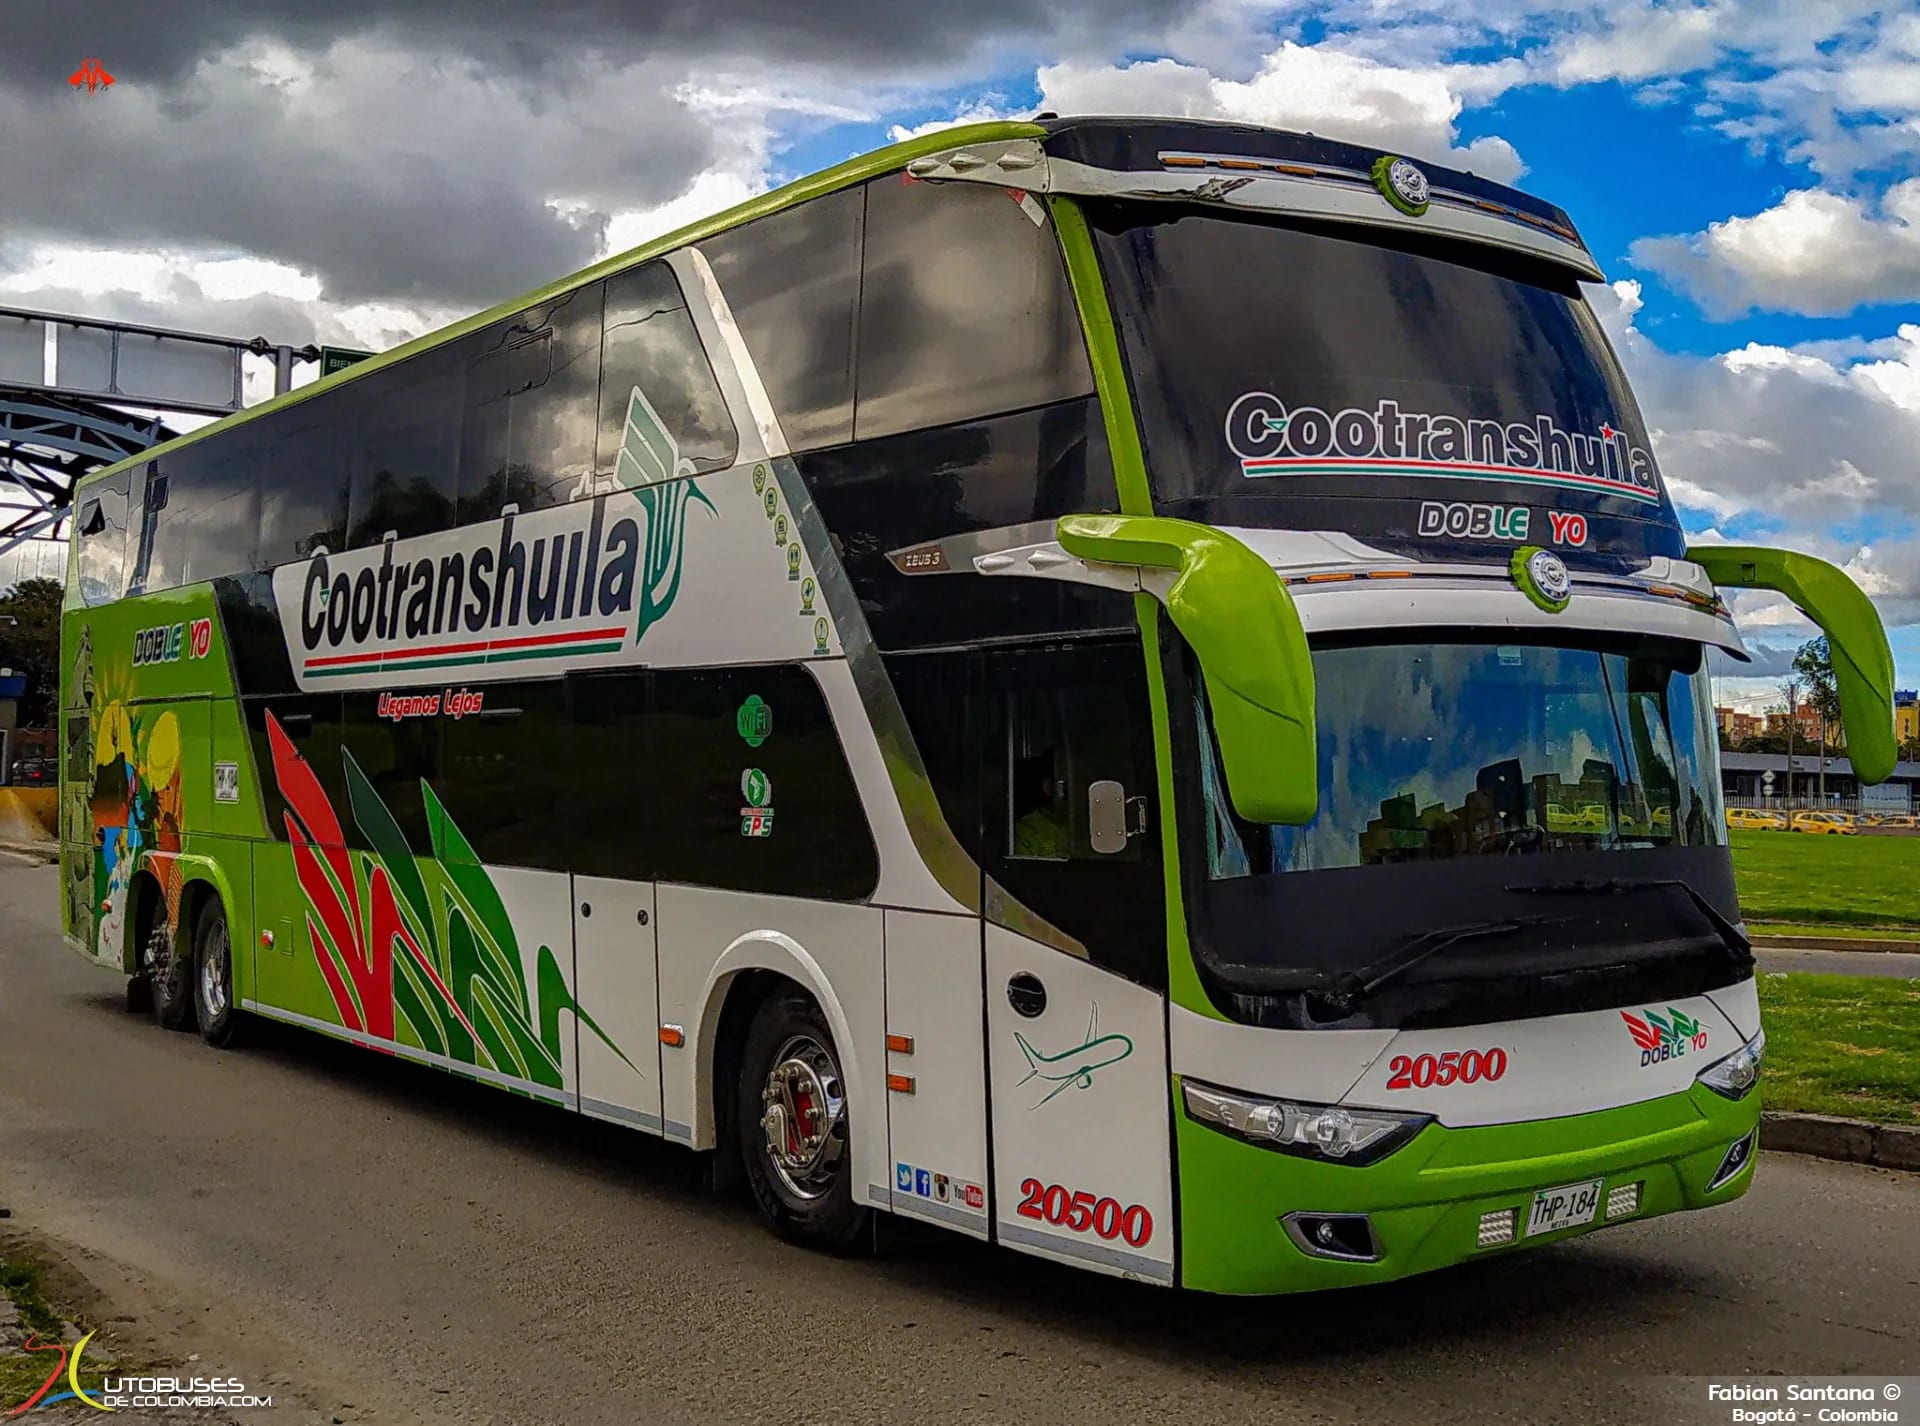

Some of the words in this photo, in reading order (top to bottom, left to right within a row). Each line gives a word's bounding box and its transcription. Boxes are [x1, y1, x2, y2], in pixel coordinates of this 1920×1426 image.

[1225, 391, 1658, 491] Cootranshuila
[1417, 501, 1529, 540] DOBLE
[1547, 511, 1588, 547] YO
[302, 492, 640, 651] Cootranshuila
[132, 622, 184, 667] DOBLE
[189, 617, 212, 659] YO
[741, 816, 773, 837] GPS
[1386, 1047, 1507, 1090] 20500
[1640, 1037, 1685, 1067] DOBLE
[1691, 1032, 1708, 1052] YO
[1016, 1178, 1153, 1248] 20500
